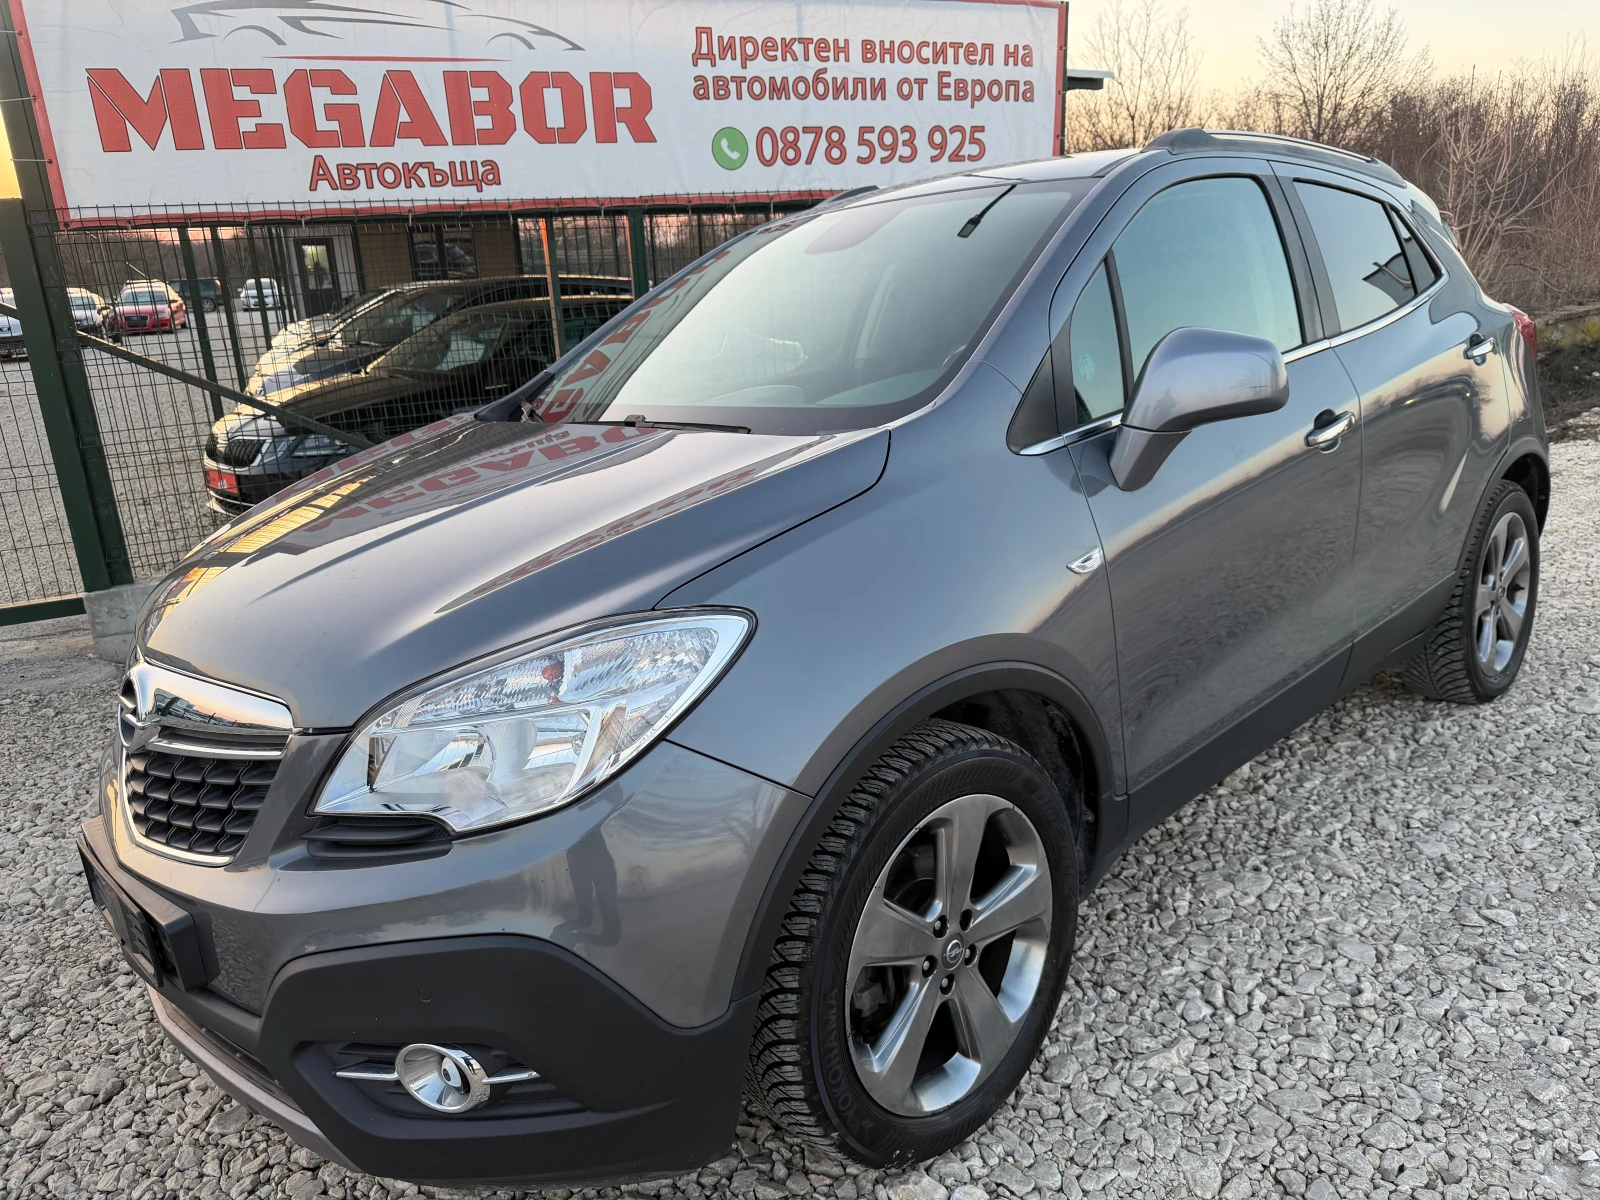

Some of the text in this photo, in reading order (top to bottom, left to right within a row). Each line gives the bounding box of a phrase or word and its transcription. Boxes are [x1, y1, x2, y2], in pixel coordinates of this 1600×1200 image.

[692, 26, 1034, 69] Директен вносител на
[692, 67, 1035, 109] автомобили от Европа
[86, 68, 657, 152] MEGABOR
[755, 125, 986, 168] 0878 593 925
[309, 155, 502, 193] Автокъща
[822, 986, 858, 1121] YOKOHAMA
